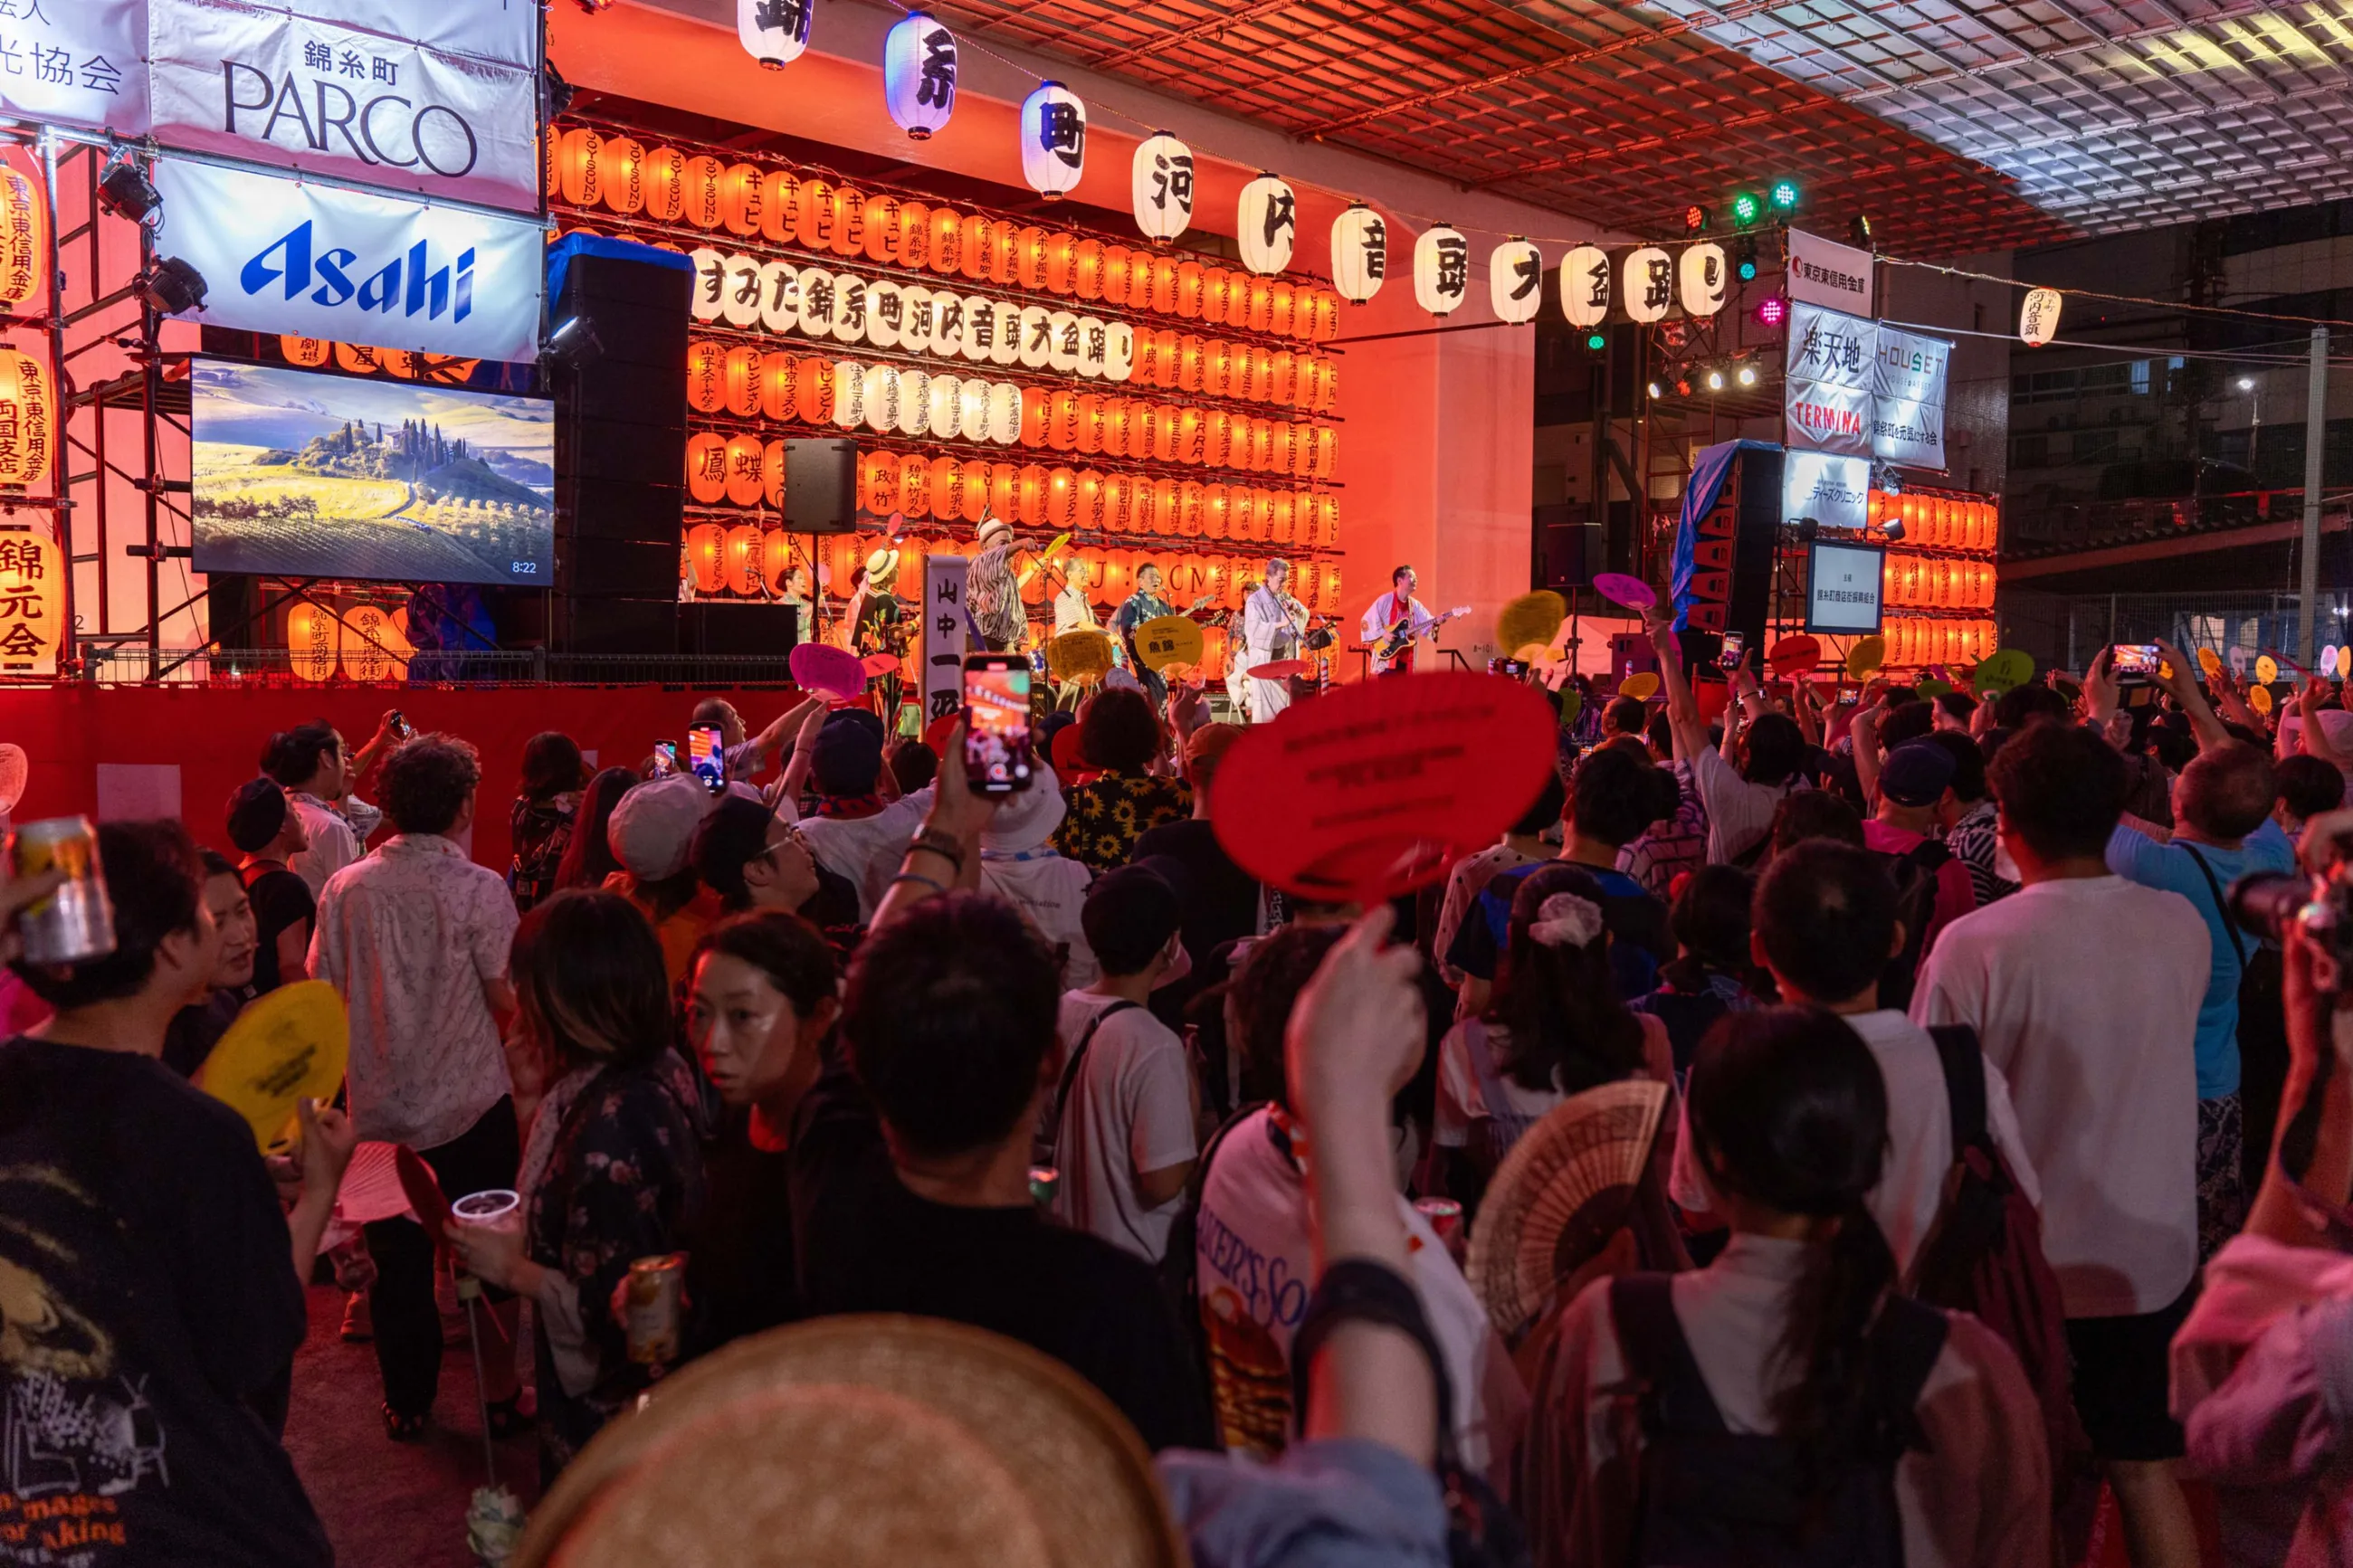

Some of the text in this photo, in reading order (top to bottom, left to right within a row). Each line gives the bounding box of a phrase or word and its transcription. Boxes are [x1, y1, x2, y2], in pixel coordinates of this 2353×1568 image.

[303, 40, 398, 86] 錦糸町
[220, 60, 478, 178] PARCO
[583, 132, 597, 202] JOYSOUND
[627, 140, 640, 209] JOYSOUND
[666, 154, 681, 217] JOYSOUND
[704, 159, 717, 223] JOYSOUND
[1151, 152, 1193, 214] 河
[4, 175, 33, 300] 東京東信用金庫
[240, 219, 475, 324] Asahi
[1804, 262, 1865, 294] 東京東信用金庫
[2024, 290, 2046, 336] 河内音頭
[1803, 327, 1861, 374] 楽天地
[1878, 342, 1943, 377] HOUSET
[782, 356, 798, 417] 東京フェスタ
[16, 359, 46, 481] 東京東信用金庫
[1796, 402, 1861, 435] TERMINA
[511, 561, 538, 574] 8:22
